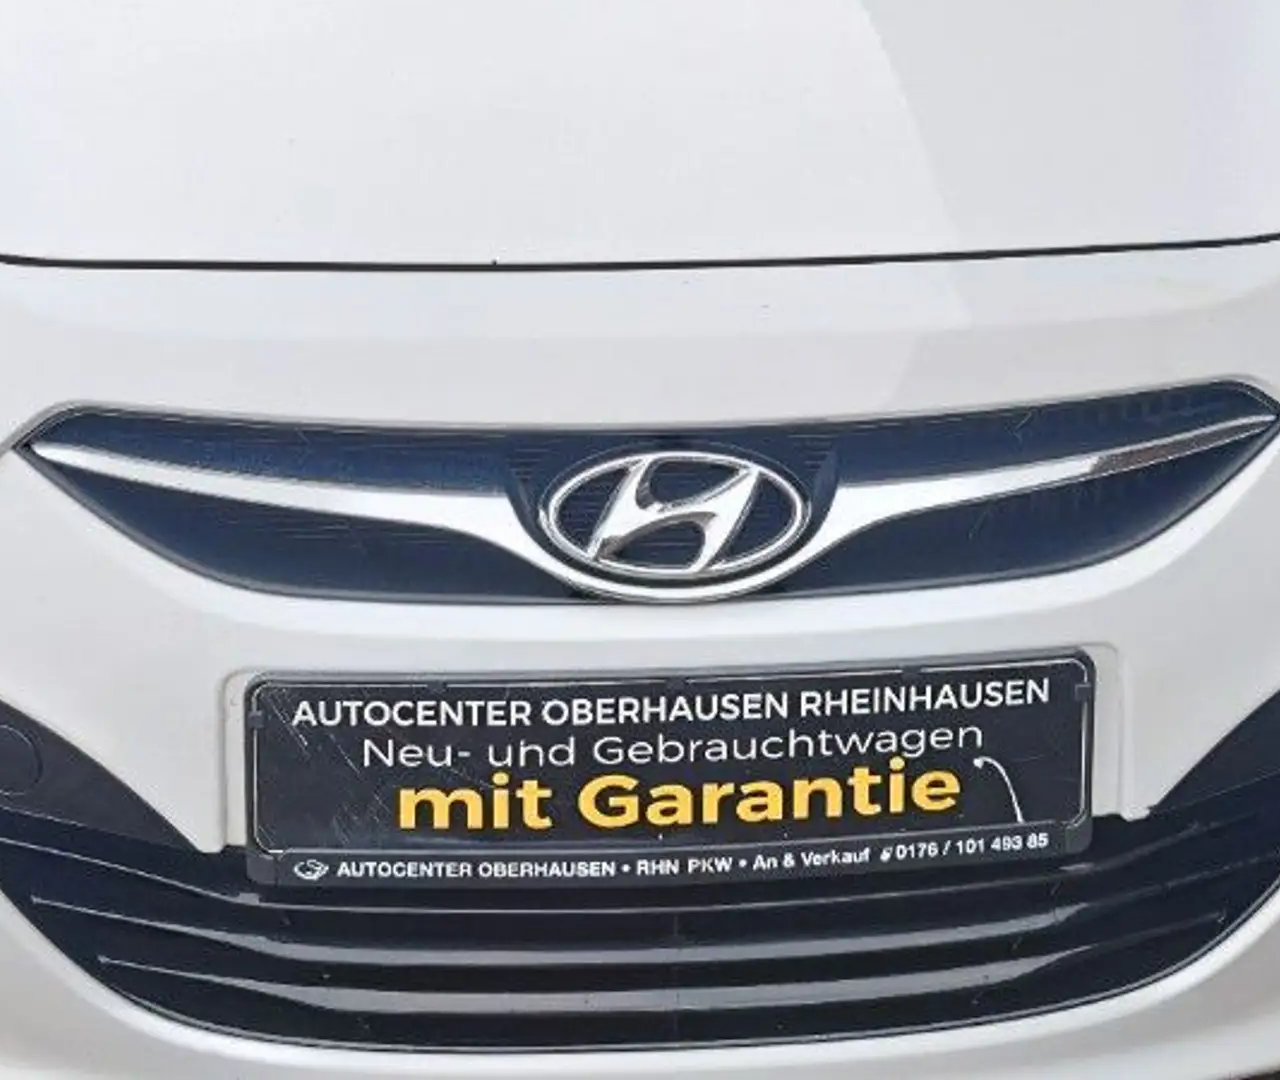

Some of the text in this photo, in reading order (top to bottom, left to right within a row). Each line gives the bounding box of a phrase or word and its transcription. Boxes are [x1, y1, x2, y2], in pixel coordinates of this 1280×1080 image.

[293, 678, 1050, 727] AUTOCENTER OBERHAUSEN RHEINHAUSEN
[364, 725, 983, 768] Neu- und Gebrauchtwagen
[399, 756, 962, 831] mit Garantie
[337, 861, 472, 879] AUTOCENTER
[478, 861, 616, 879] OBERHAUSEN
[636, 858, 680, 876] RHN
[687, 856, 733, 874] PKW
[752, 853, 779, 871] An
[801, 847, 870, 866] Verkauf
[896, 843, 939, 860] 0176
[956, 838, 986, 854] 101
